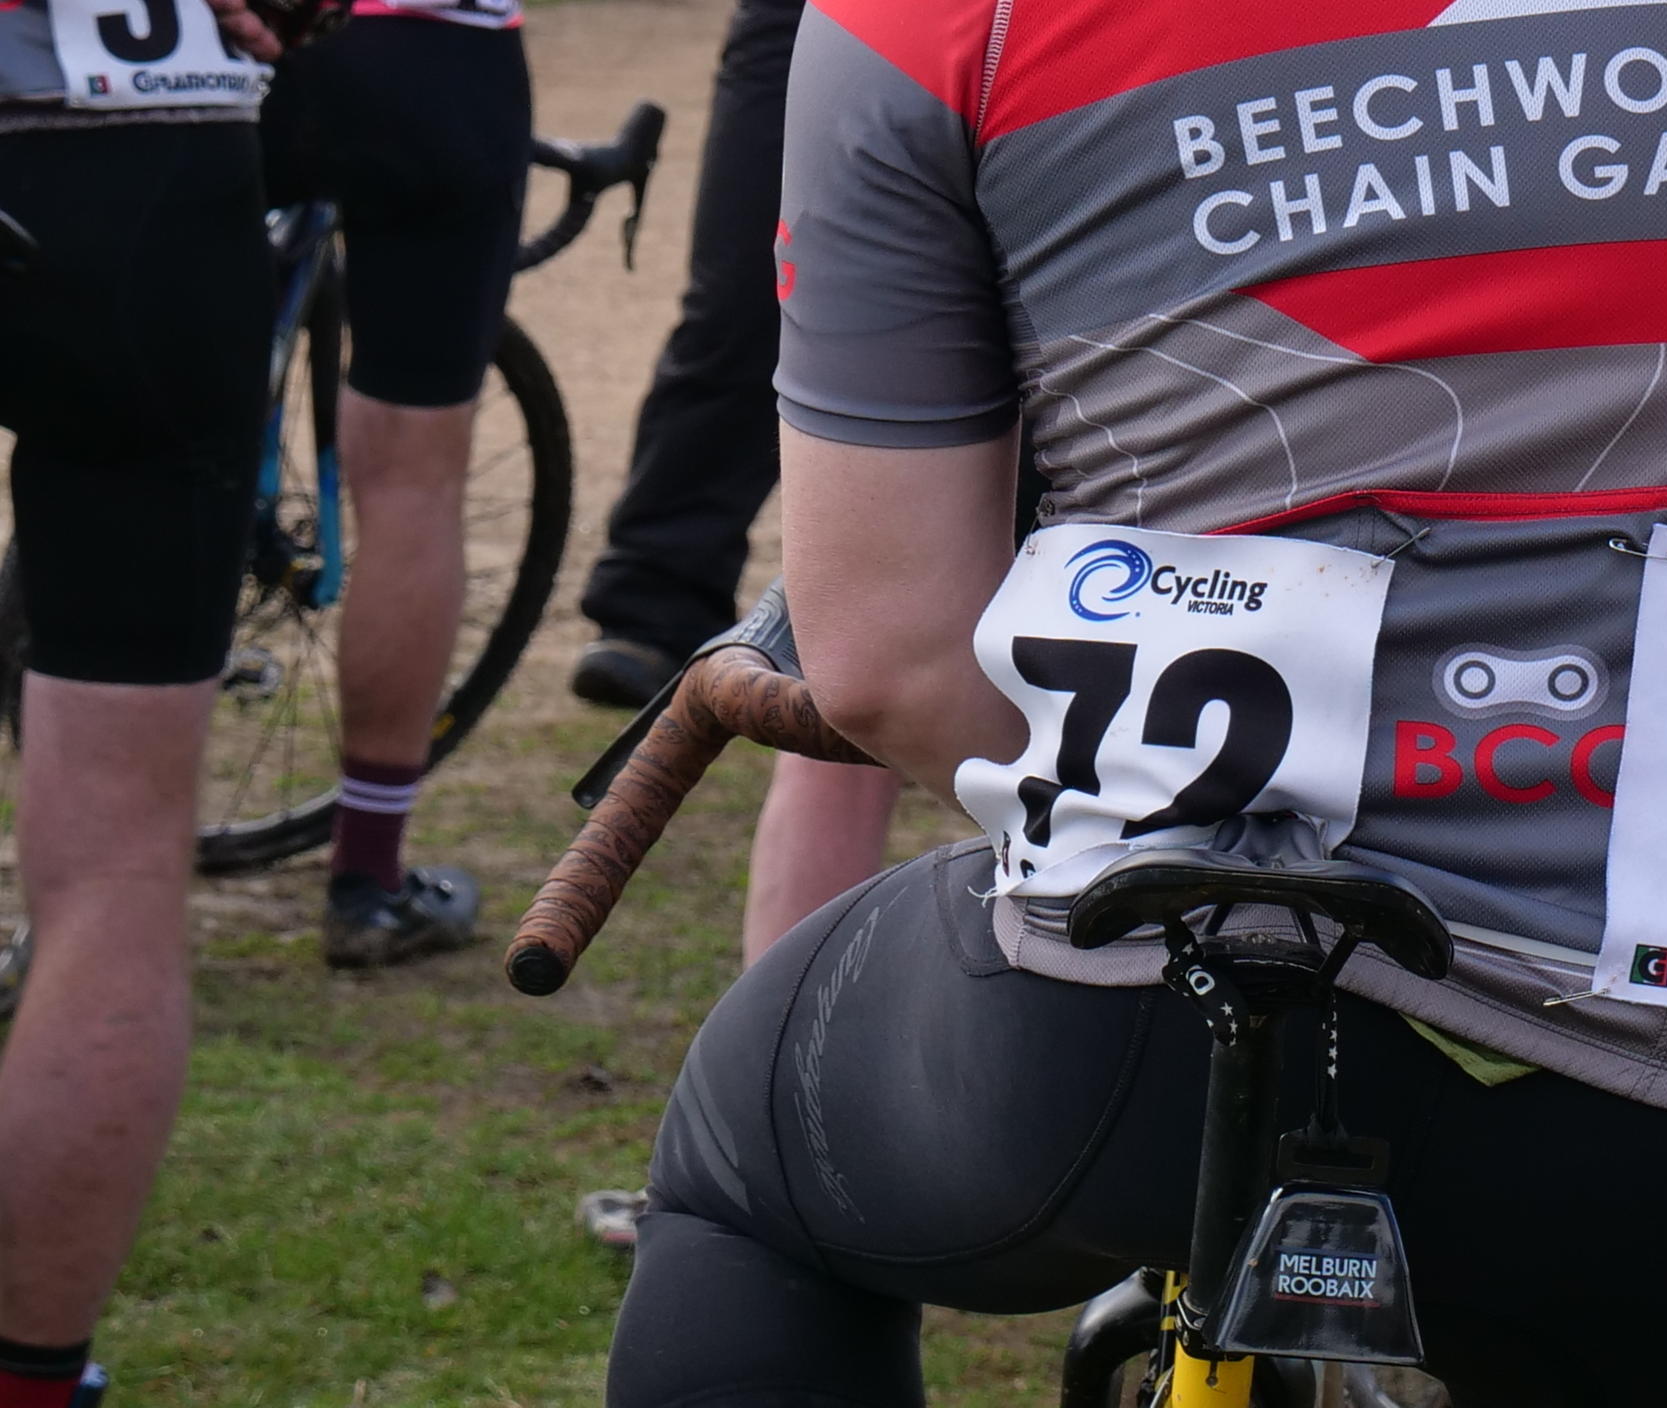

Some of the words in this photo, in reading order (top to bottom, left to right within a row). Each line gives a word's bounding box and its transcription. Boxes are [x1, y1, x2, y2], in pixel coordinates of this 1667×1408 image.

[1192, 145, 1511, 255] CHAIN
[1150, 565, 1268, 611] Cycling
[1187, 599, 1234, 616] VICTORIA
[1011, 635, 1294, 849] 72
[1279, 1253, 1378, 1279] MELBURN
[1277, 1274, 1375, 1300] ROOBAIX
